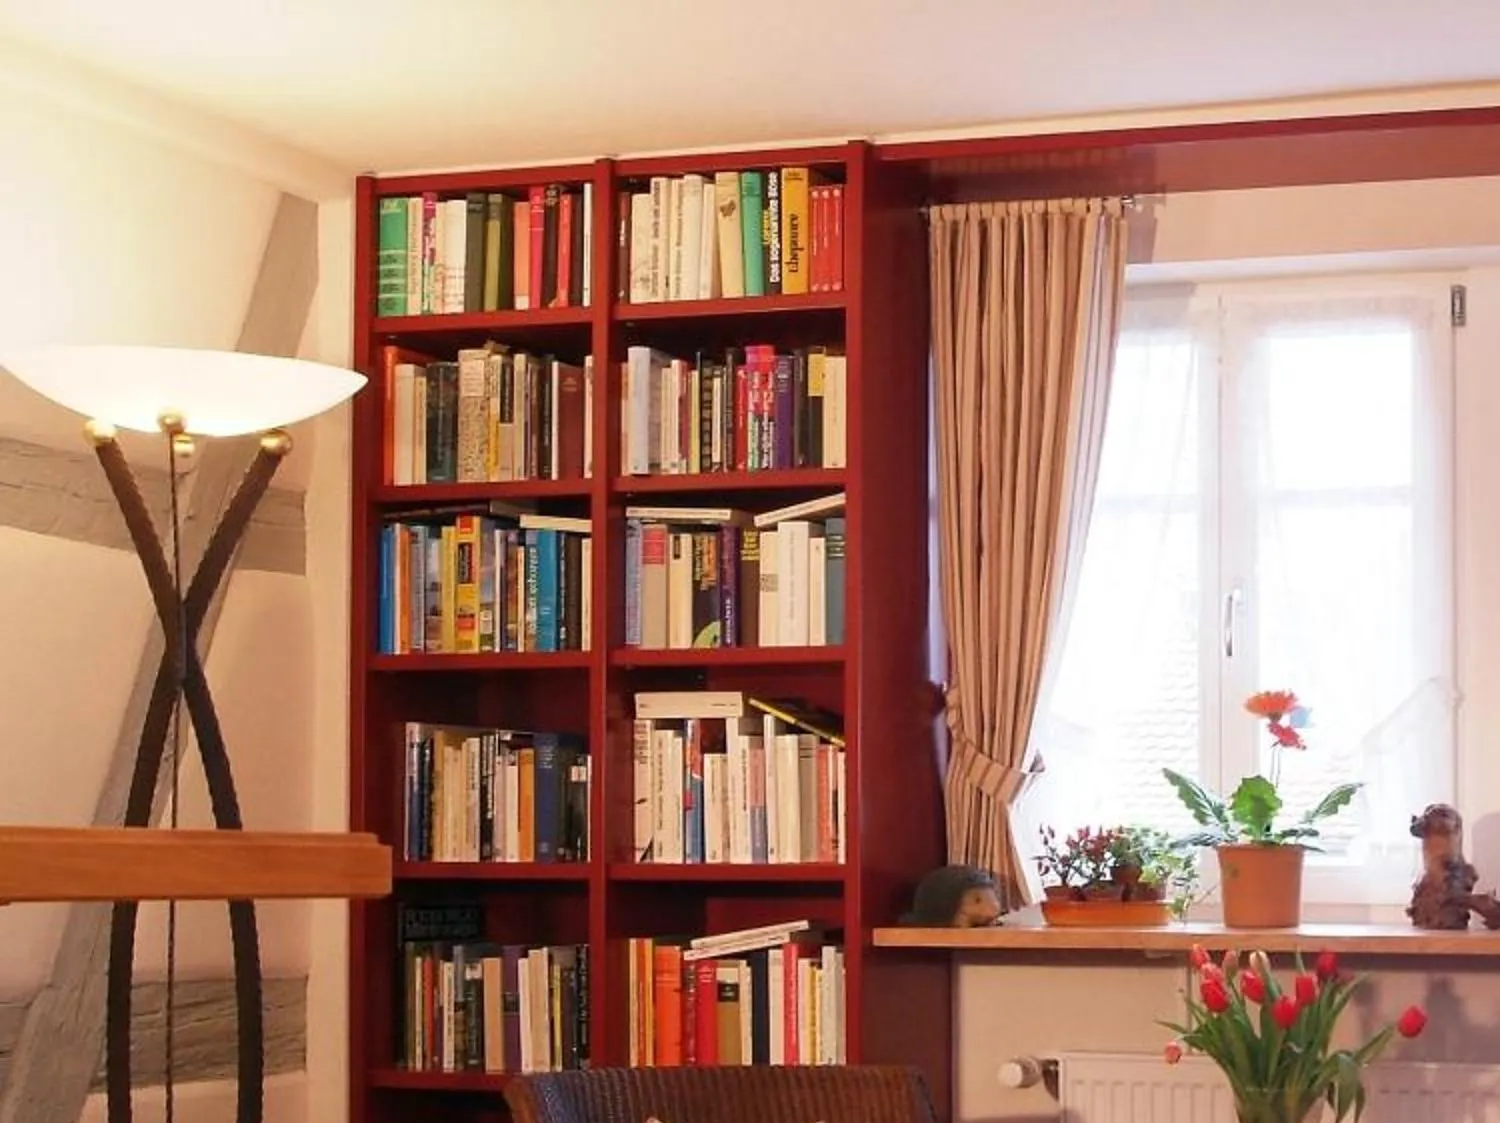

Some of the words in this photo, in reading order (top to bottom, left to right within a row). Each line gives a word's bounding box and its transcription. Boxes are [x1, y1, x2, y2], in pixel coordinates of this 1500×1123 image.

[767, 171, 778, 198] Böse
[769, 199, 780, 261] sogenannte
[769, 263, 780, 283] Das
